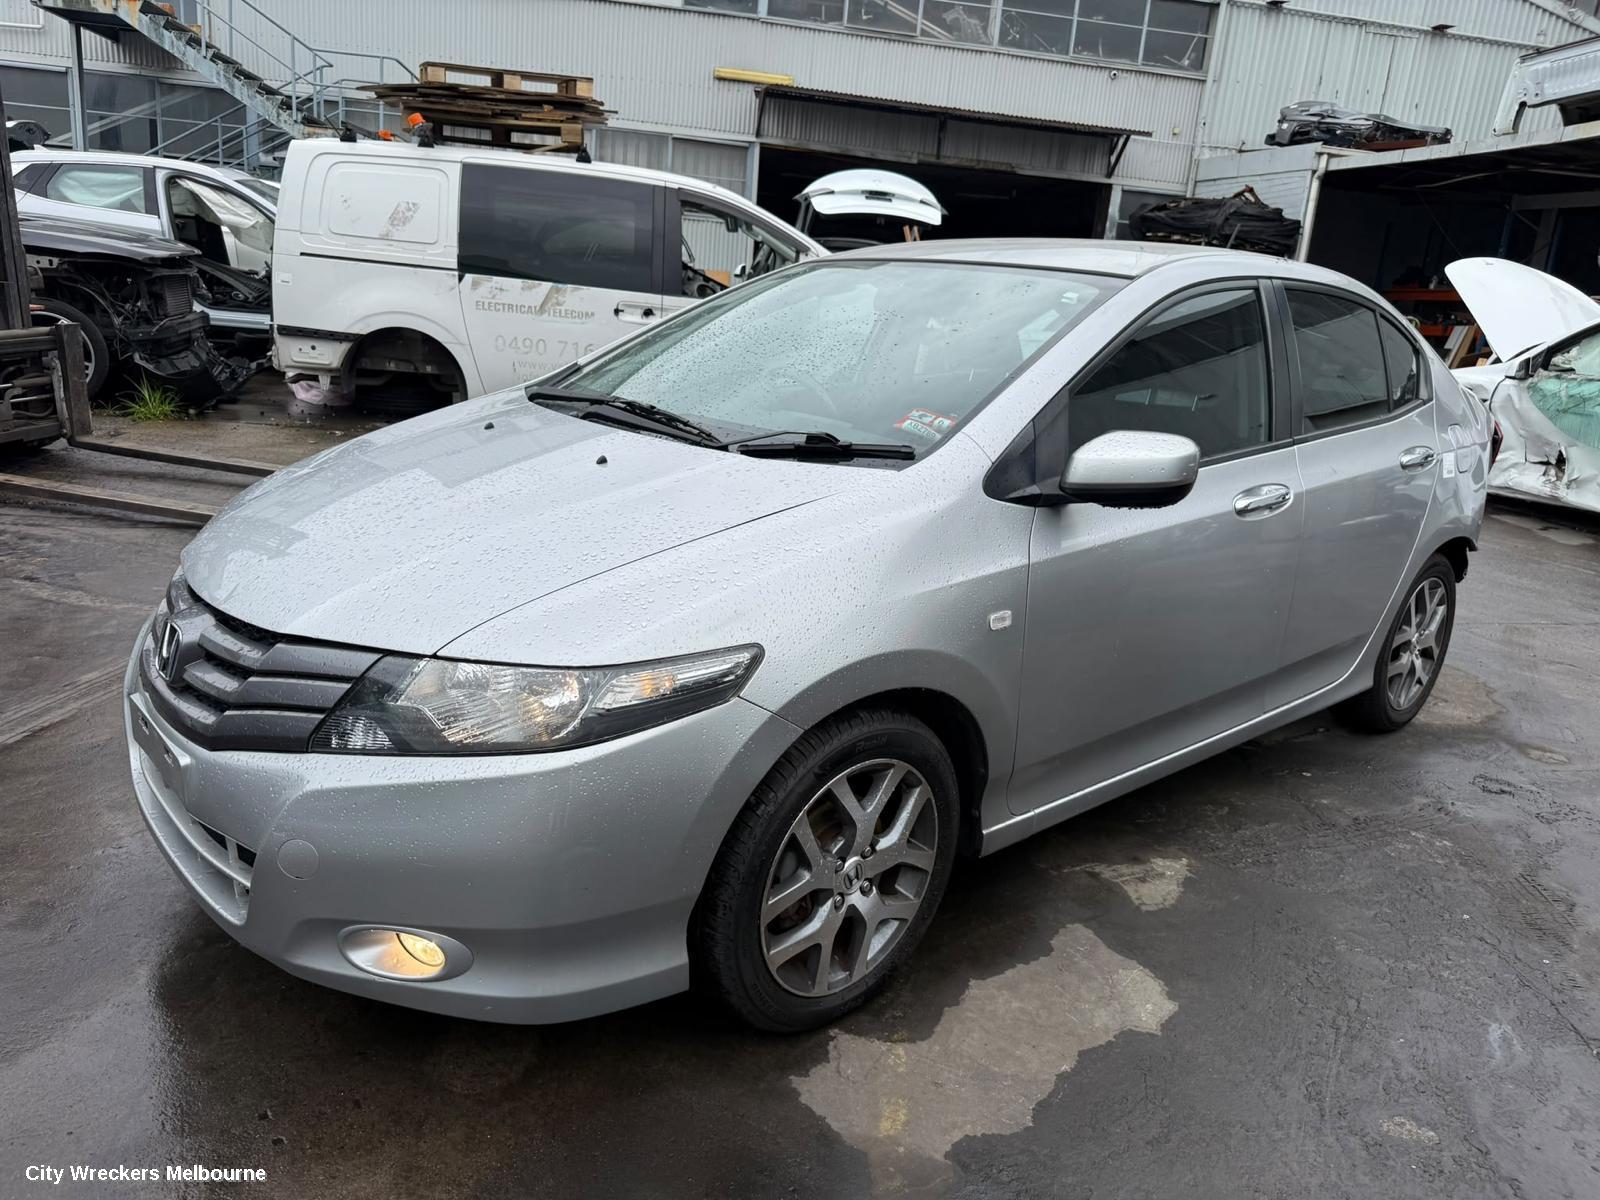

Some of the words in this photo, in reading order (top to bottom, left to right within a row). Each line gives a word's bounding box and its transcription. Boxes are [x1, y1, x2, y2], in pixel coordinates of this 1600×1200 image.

[475, 300, 541, 316] ELECTRICAL
[547, 307, 595, 320] TELECOM
[495, 334, 547, 356] 0490
